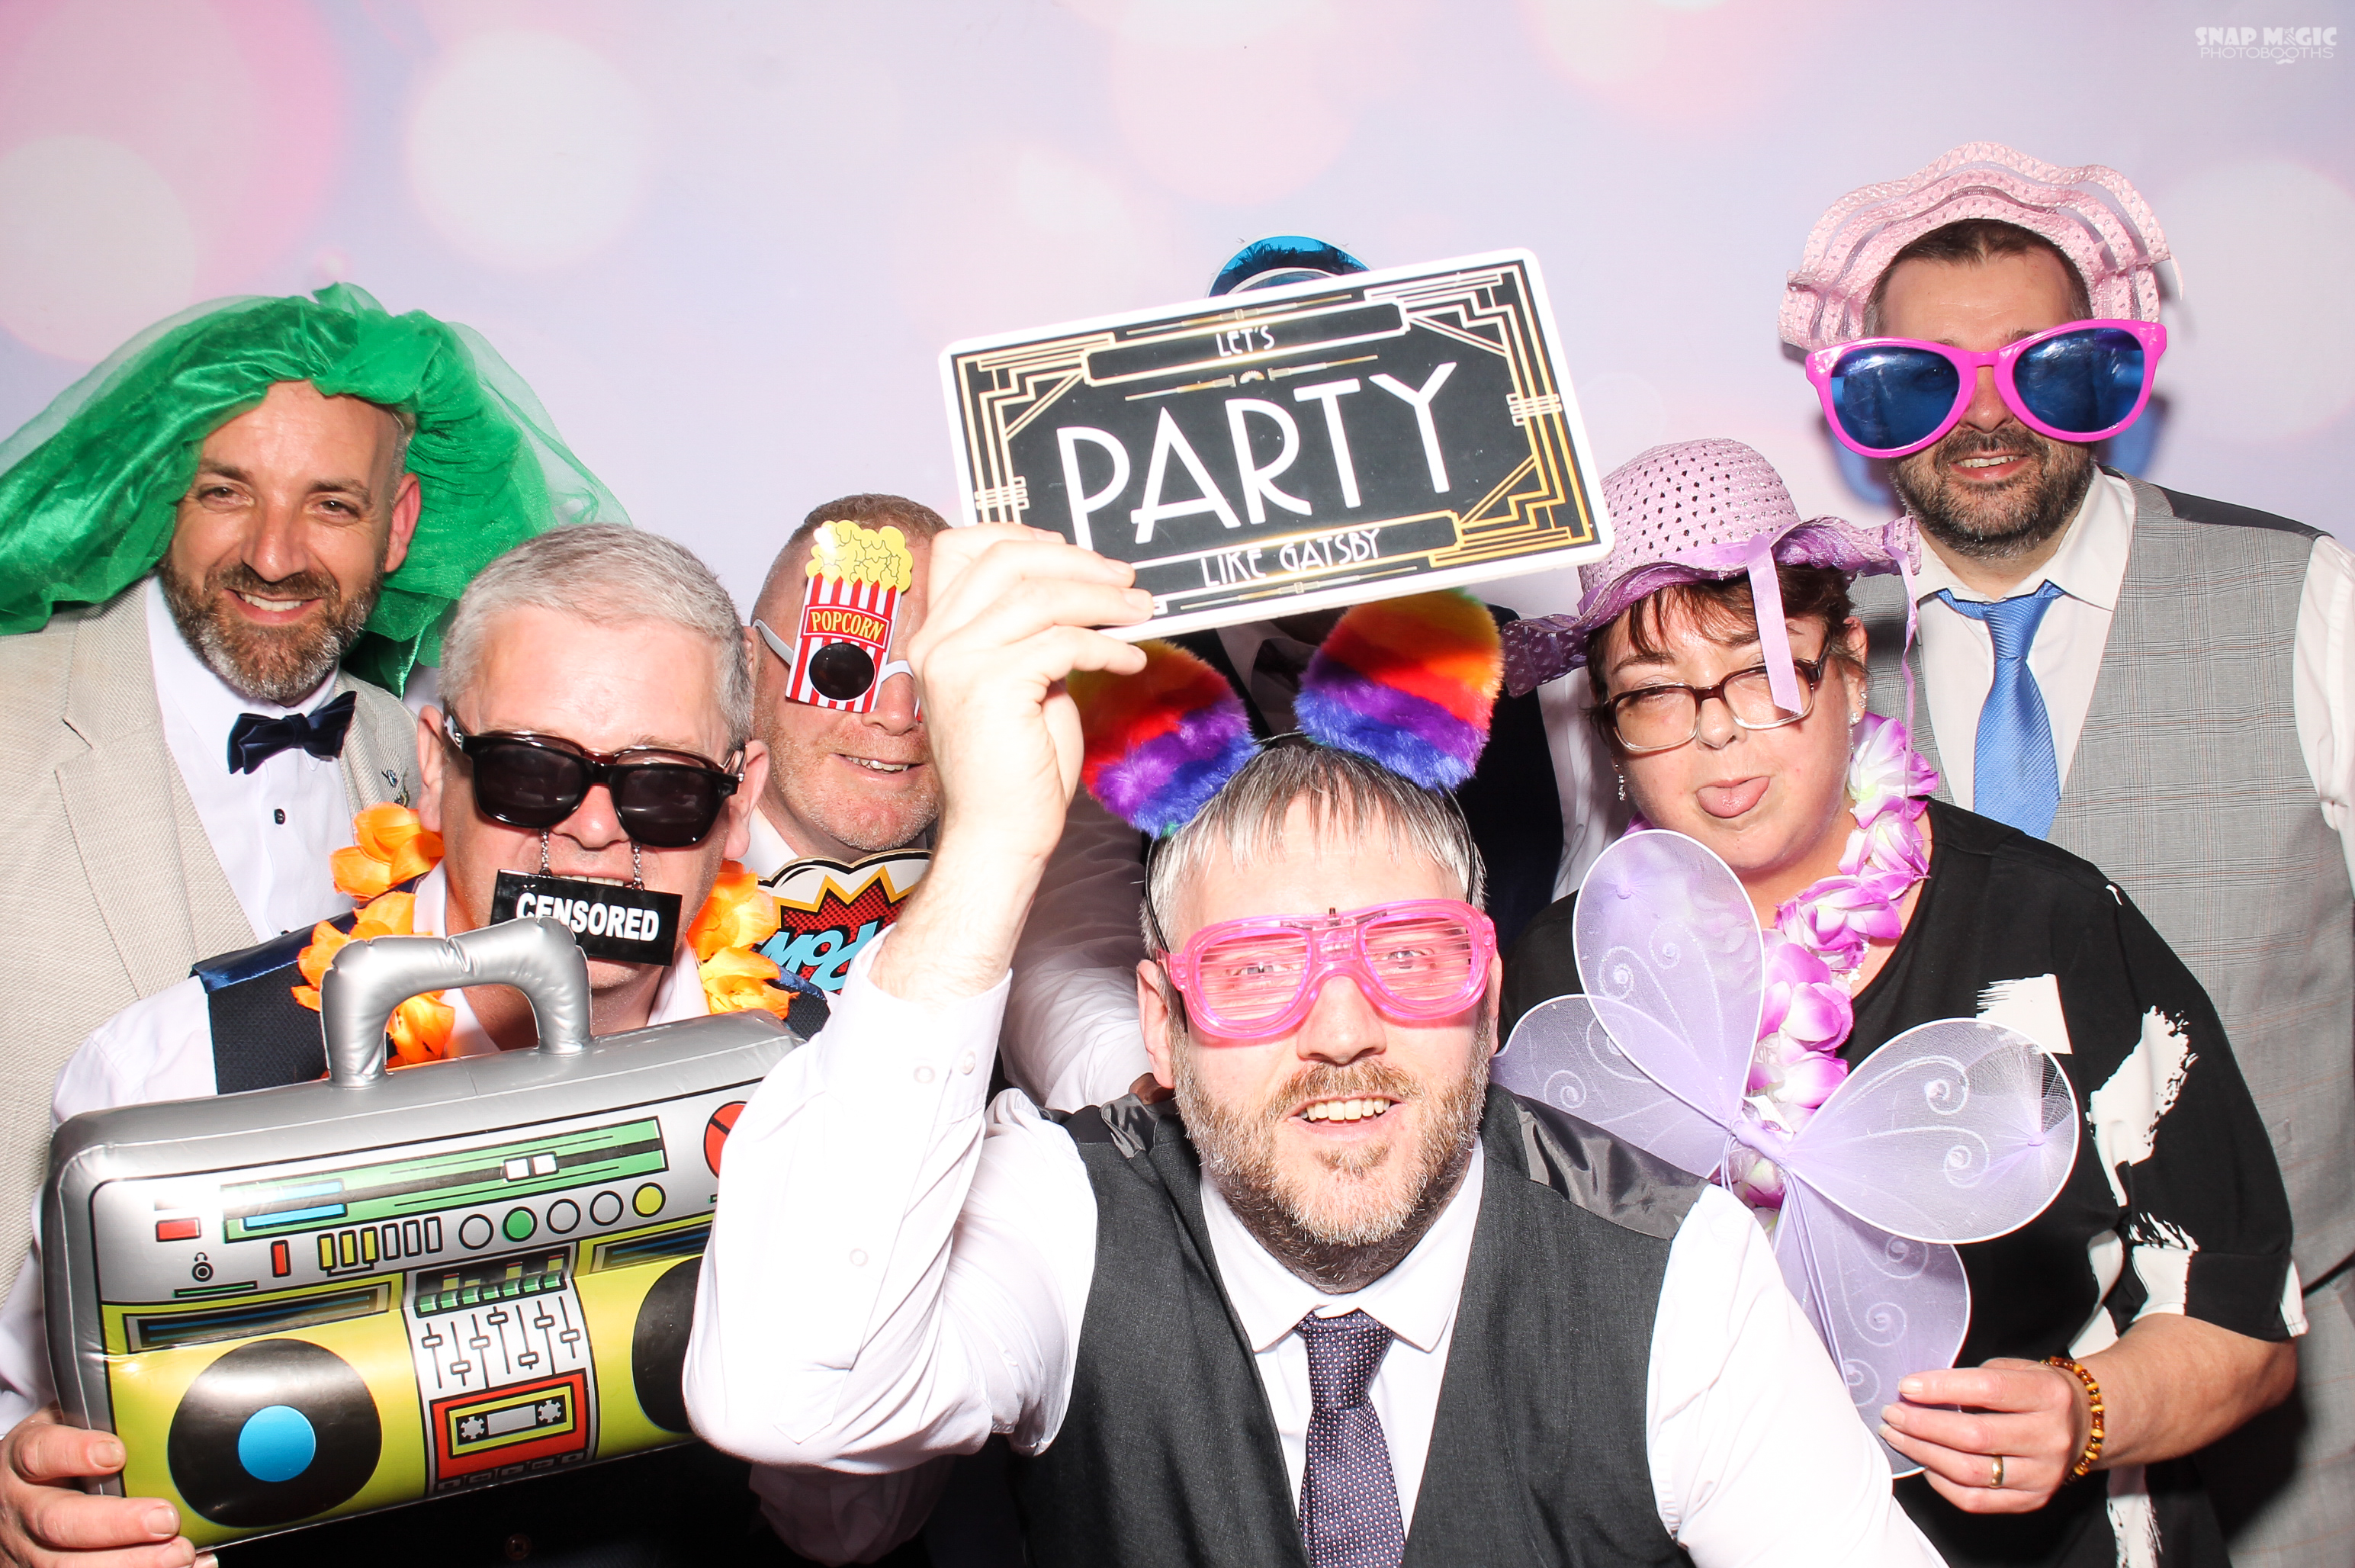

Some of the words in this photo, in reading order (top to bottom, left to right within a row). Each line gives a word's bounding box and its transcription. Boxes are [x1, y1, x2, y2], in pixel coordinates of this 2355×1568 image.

[1215, 325, 1275, 358] LET'S
[1056, 361, 1458, 552] PARTY
[1200, 548, 1267, 587] LIKE
[1278, 528, 1380, 573] GATSBY
[811, 610, 885, 643] POPCORN
[516, 892, 660, 942] CENSORED
